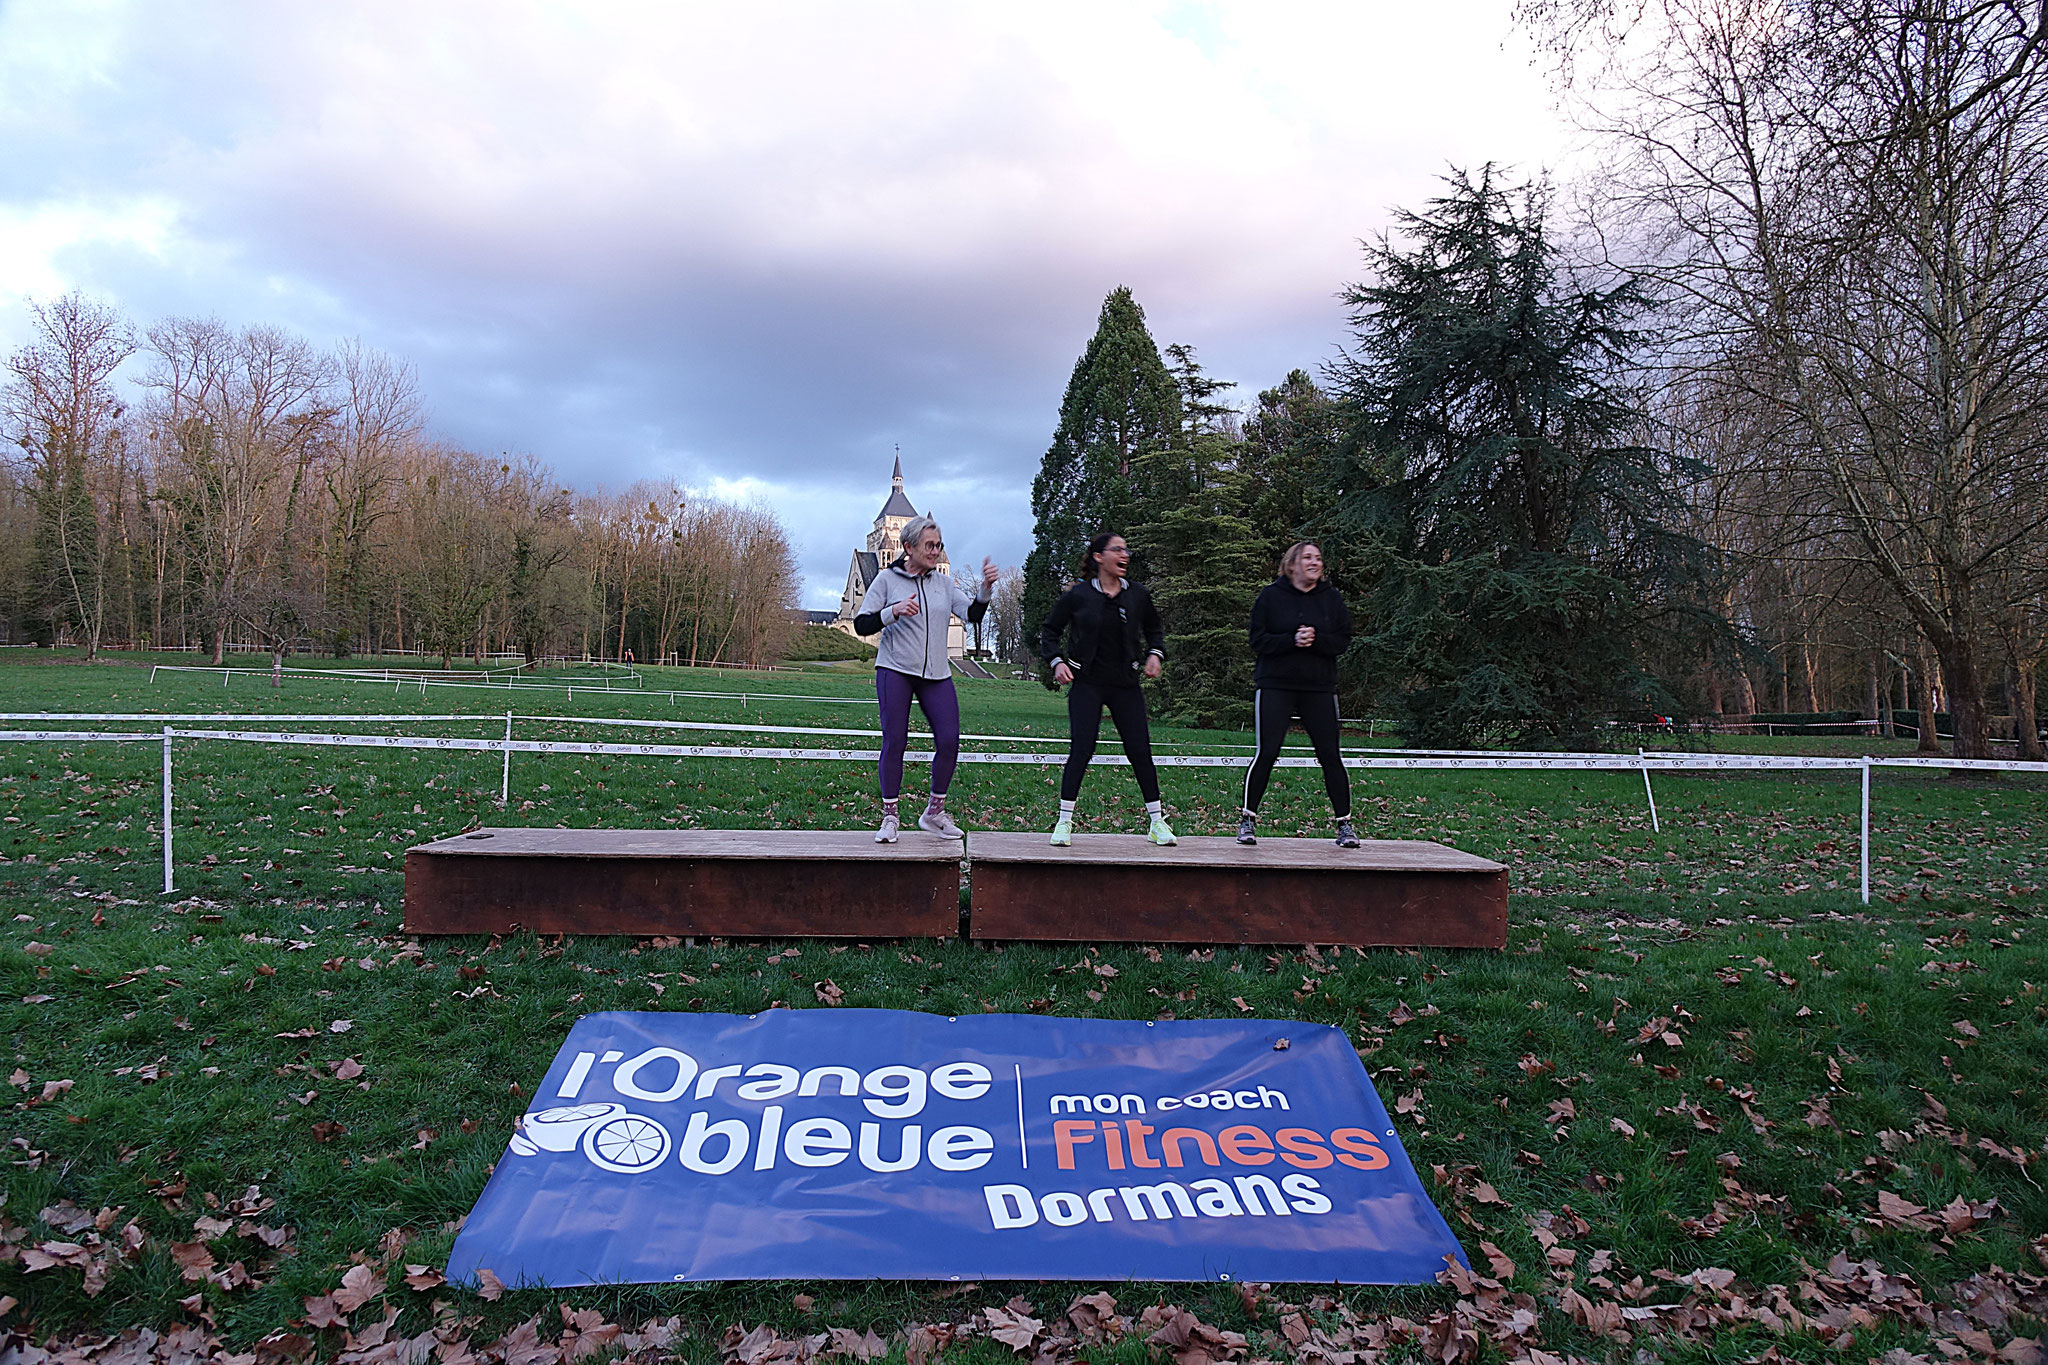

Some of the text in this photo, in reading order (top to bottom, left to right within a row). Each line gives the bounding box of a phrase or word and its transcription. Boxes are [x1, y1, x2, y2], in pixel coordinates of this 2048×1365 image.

[557, 1046, 993, 1119] l'Orange
[1050, 1085, 1291, 1114] mon coach
[678, 1105, 995, 1175] bleue
[1053, 1118, 1390, 1171] Fitness
[983, 1173, 1333, 1230] Dormans
